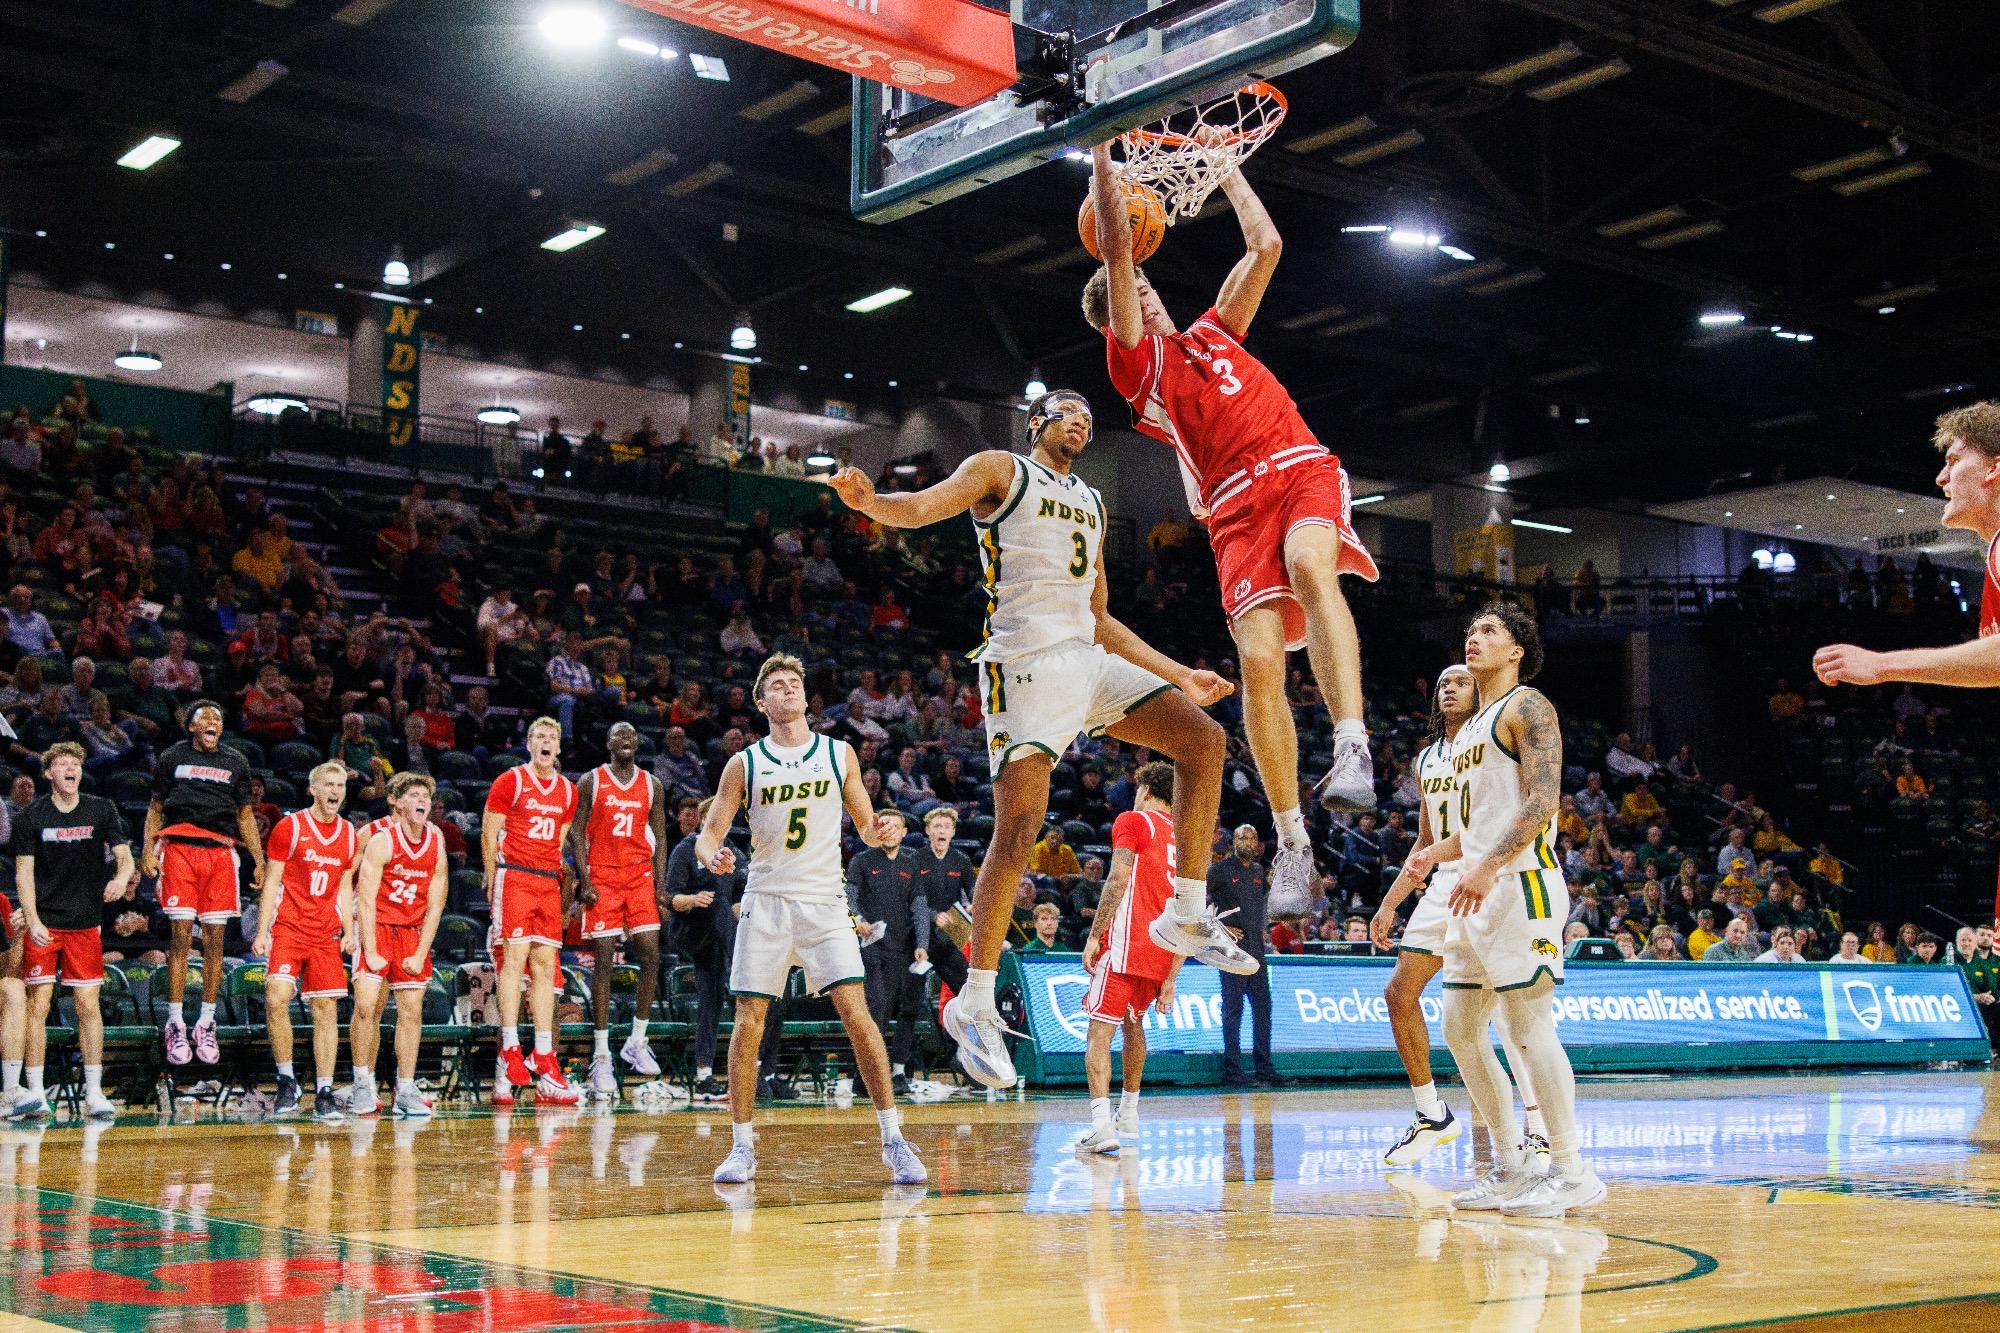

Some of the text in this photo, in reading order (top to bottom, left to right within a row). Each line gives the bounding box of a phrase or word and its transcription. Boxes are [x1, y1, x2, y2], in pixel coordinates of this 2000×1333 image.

[385, 305, 420, 446] NDSU
[1212, 358, 1242, 396] 3
[1037, 497, 1097, 531] NDSU
[1068, 530, 1088, 579] 3
[1877, 529, 1939, 550] TACO SHOP
[760, 780, 831, 806] NDSU
[1460, 779, 1471, 831] 0
[527, 815, 556, 841] 20
[612, 812, 634, 838] 21
[784, 806, 809, 852] 5
[1438, 800, 1452, 840] 1
[310, 869, 329, 897] 10
[388, 880, 418, 905] 24
[1295, 988, 1391, 1023] Backe
[1551, 989, 1714, 1028] personalized
[1715, 989, 1809, 1021] service.
[1885, 986, 1962, 1022] fmne
